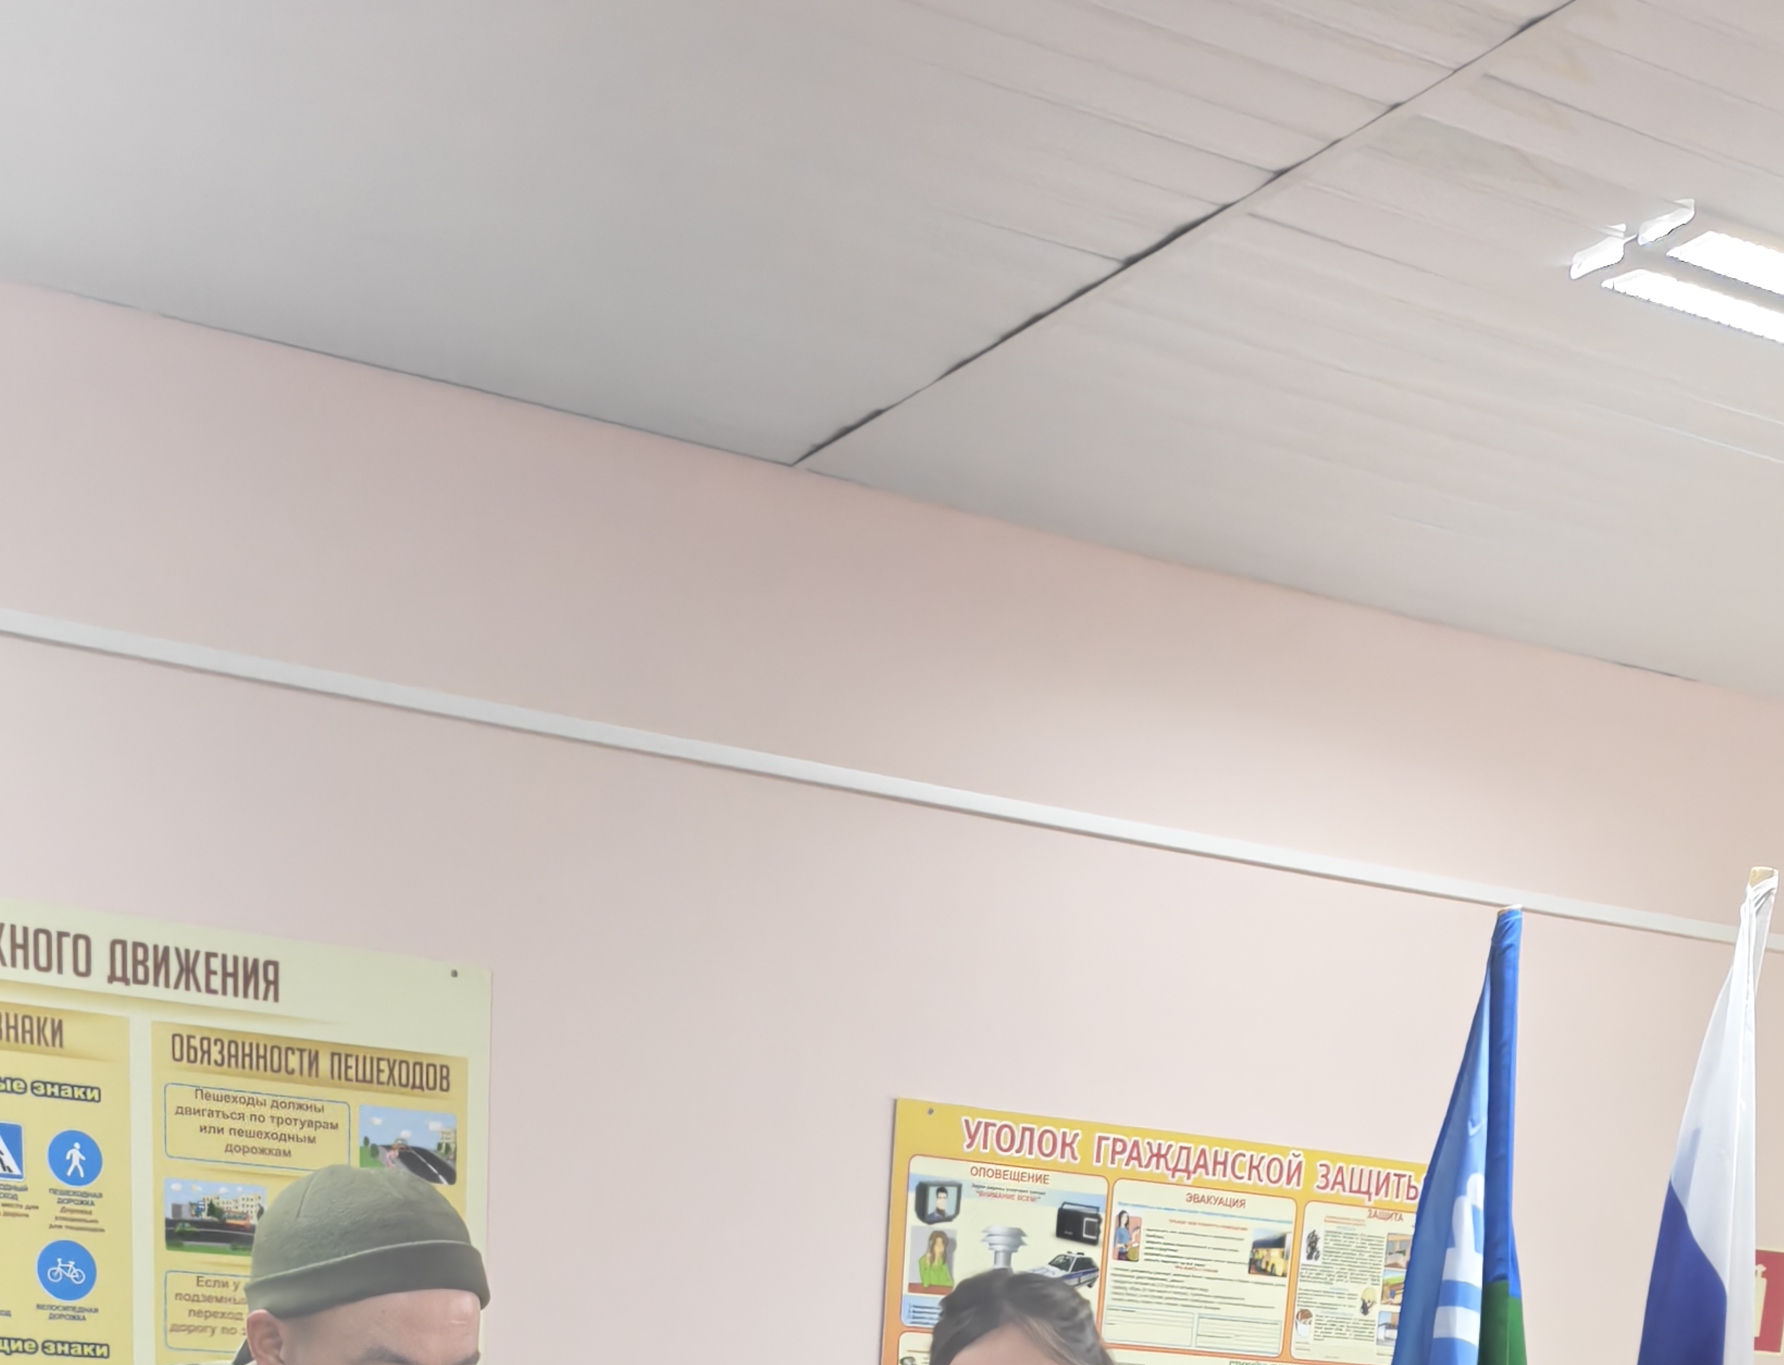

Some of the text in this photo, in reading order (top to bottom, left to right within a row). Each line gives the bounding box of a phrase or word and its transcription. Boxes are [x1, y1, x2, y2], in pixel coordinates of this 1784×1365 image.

[107, 938, 280, 1003] ДВИЖЕНИЯ
[171, 1033, 451, 1093] ОБЯЗАННОСТИ ПЕШЕХОДОВ
[30, 1080, 101, 1103] знаки
[194, 1088, 325, 1114] Пешеходы должны
[174, 1105, 339, 1131] двигаться по тротуарам
[200, 1124, 316, 1144] или пешеходным
[224, 1141, 292, 1158] дорожкам
[964, 1118, 1080, 1161] УГОЛОК
[1094, 1135, 1304, 1188] ГРАЖДАНСКОЙ
[970, 1166, 1050, 1185] ОПОВЕЩЕНИЕ
[1185, 1192, 1247, 1209] ЭВАКУАЦИЯ
[196, 1275, 240, 1292] Если у
[221, 1326, 238, 1335] по
[42, 1339, 110, 1359] знаки
